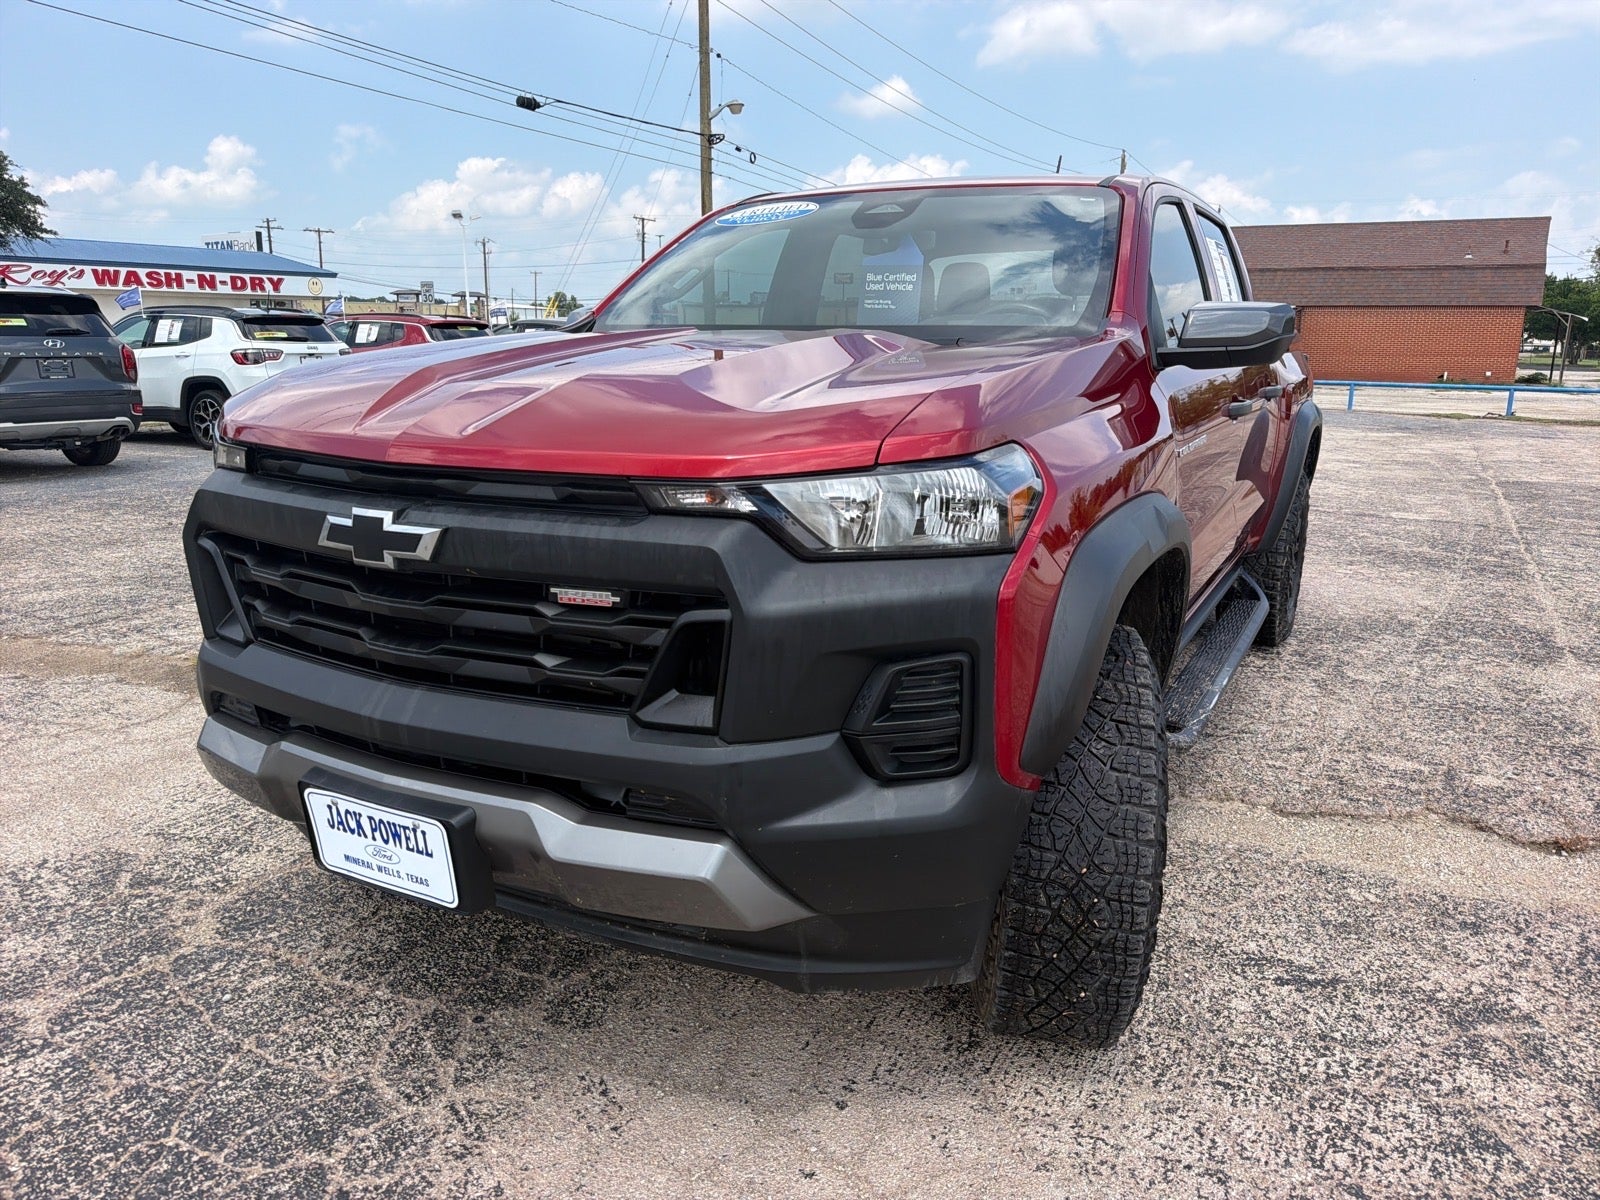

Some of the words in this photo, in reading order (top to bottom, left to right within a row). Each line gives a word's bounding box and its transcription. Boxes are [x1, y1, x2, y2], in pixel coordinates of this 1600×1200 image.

[0, 264, 85, 286] Roy's
[91, 268, 285, 294] WASH-N-DRY
[866, 272, 883, 281] Blue
[883, 272, 917, 282] Certified
[865, 282, 885, 291] Used
[885, 282, 914, 291] Vehicle
[423, 293, 434, 303] 30
[558, 596, 613, 607] BOSS
[326, 803, 368, 840] JACK
[366, 815, 434, 859] POWELL
[343, 853, 376, 872] MINERAL
[376, 863, 405, 881] WELLS,
[405, 872, 431, 888] TEXAS
